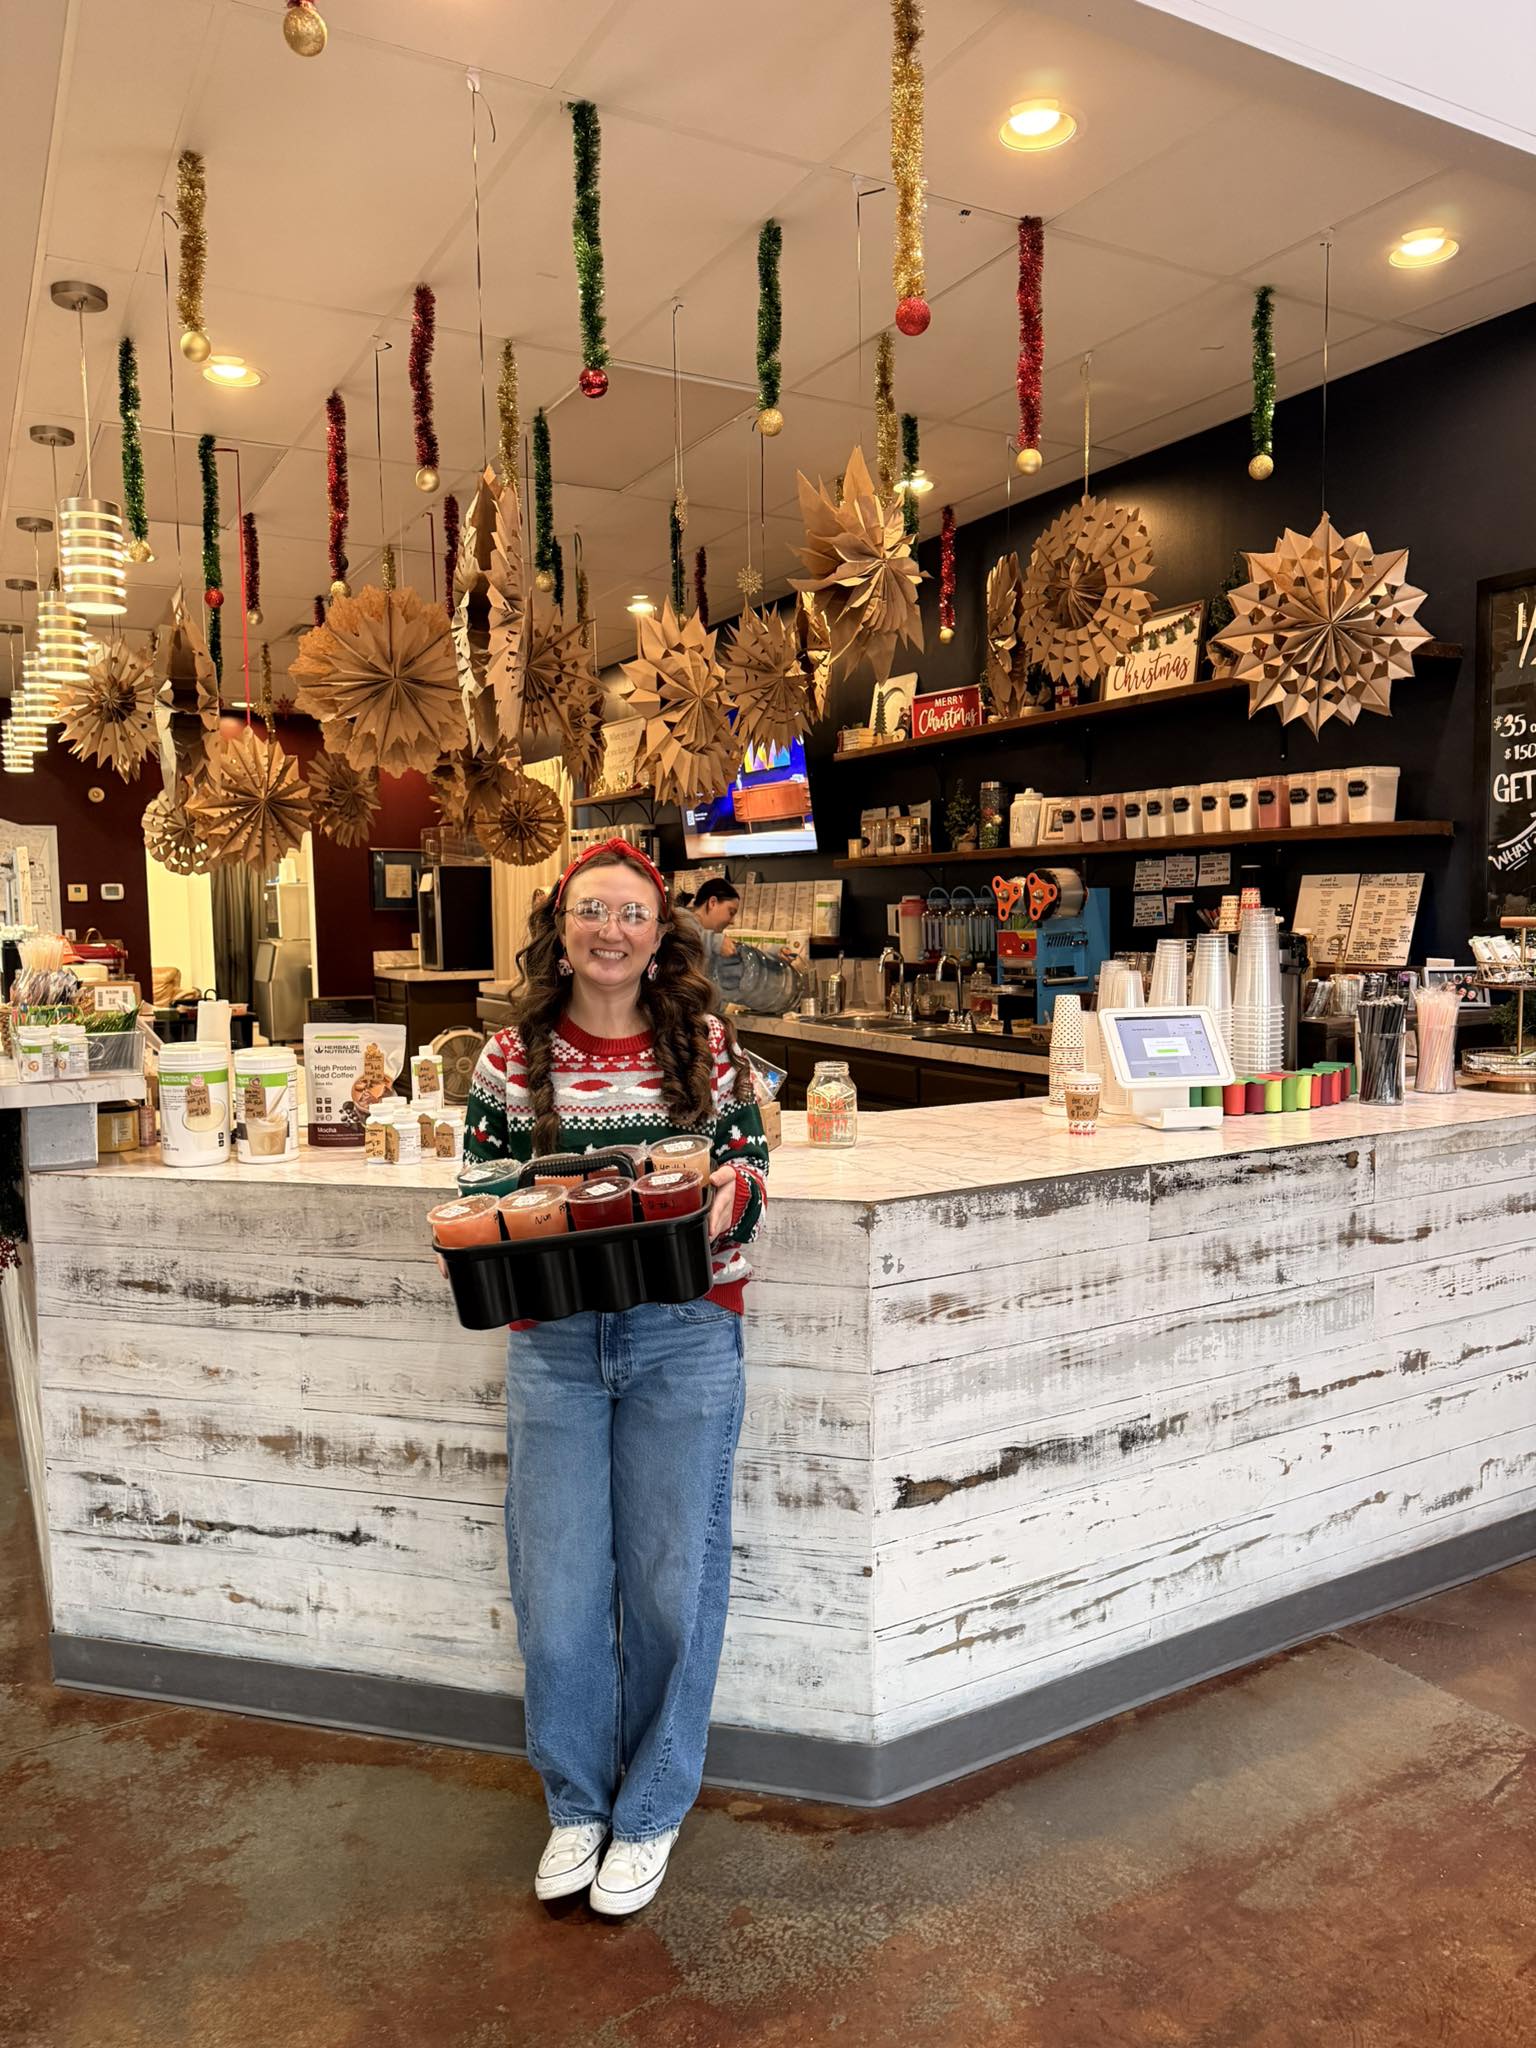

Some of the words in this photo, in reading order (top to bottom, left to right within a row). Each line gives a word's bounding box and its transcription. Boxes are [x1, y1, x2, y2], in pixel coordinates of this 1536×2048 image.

[1113, 652, 1190, 692] Christmas
[934, 694, 964, 708] MERRY
[918, 706, 978, 735] Christmas
[1493, 713, 1527, 738] $35
